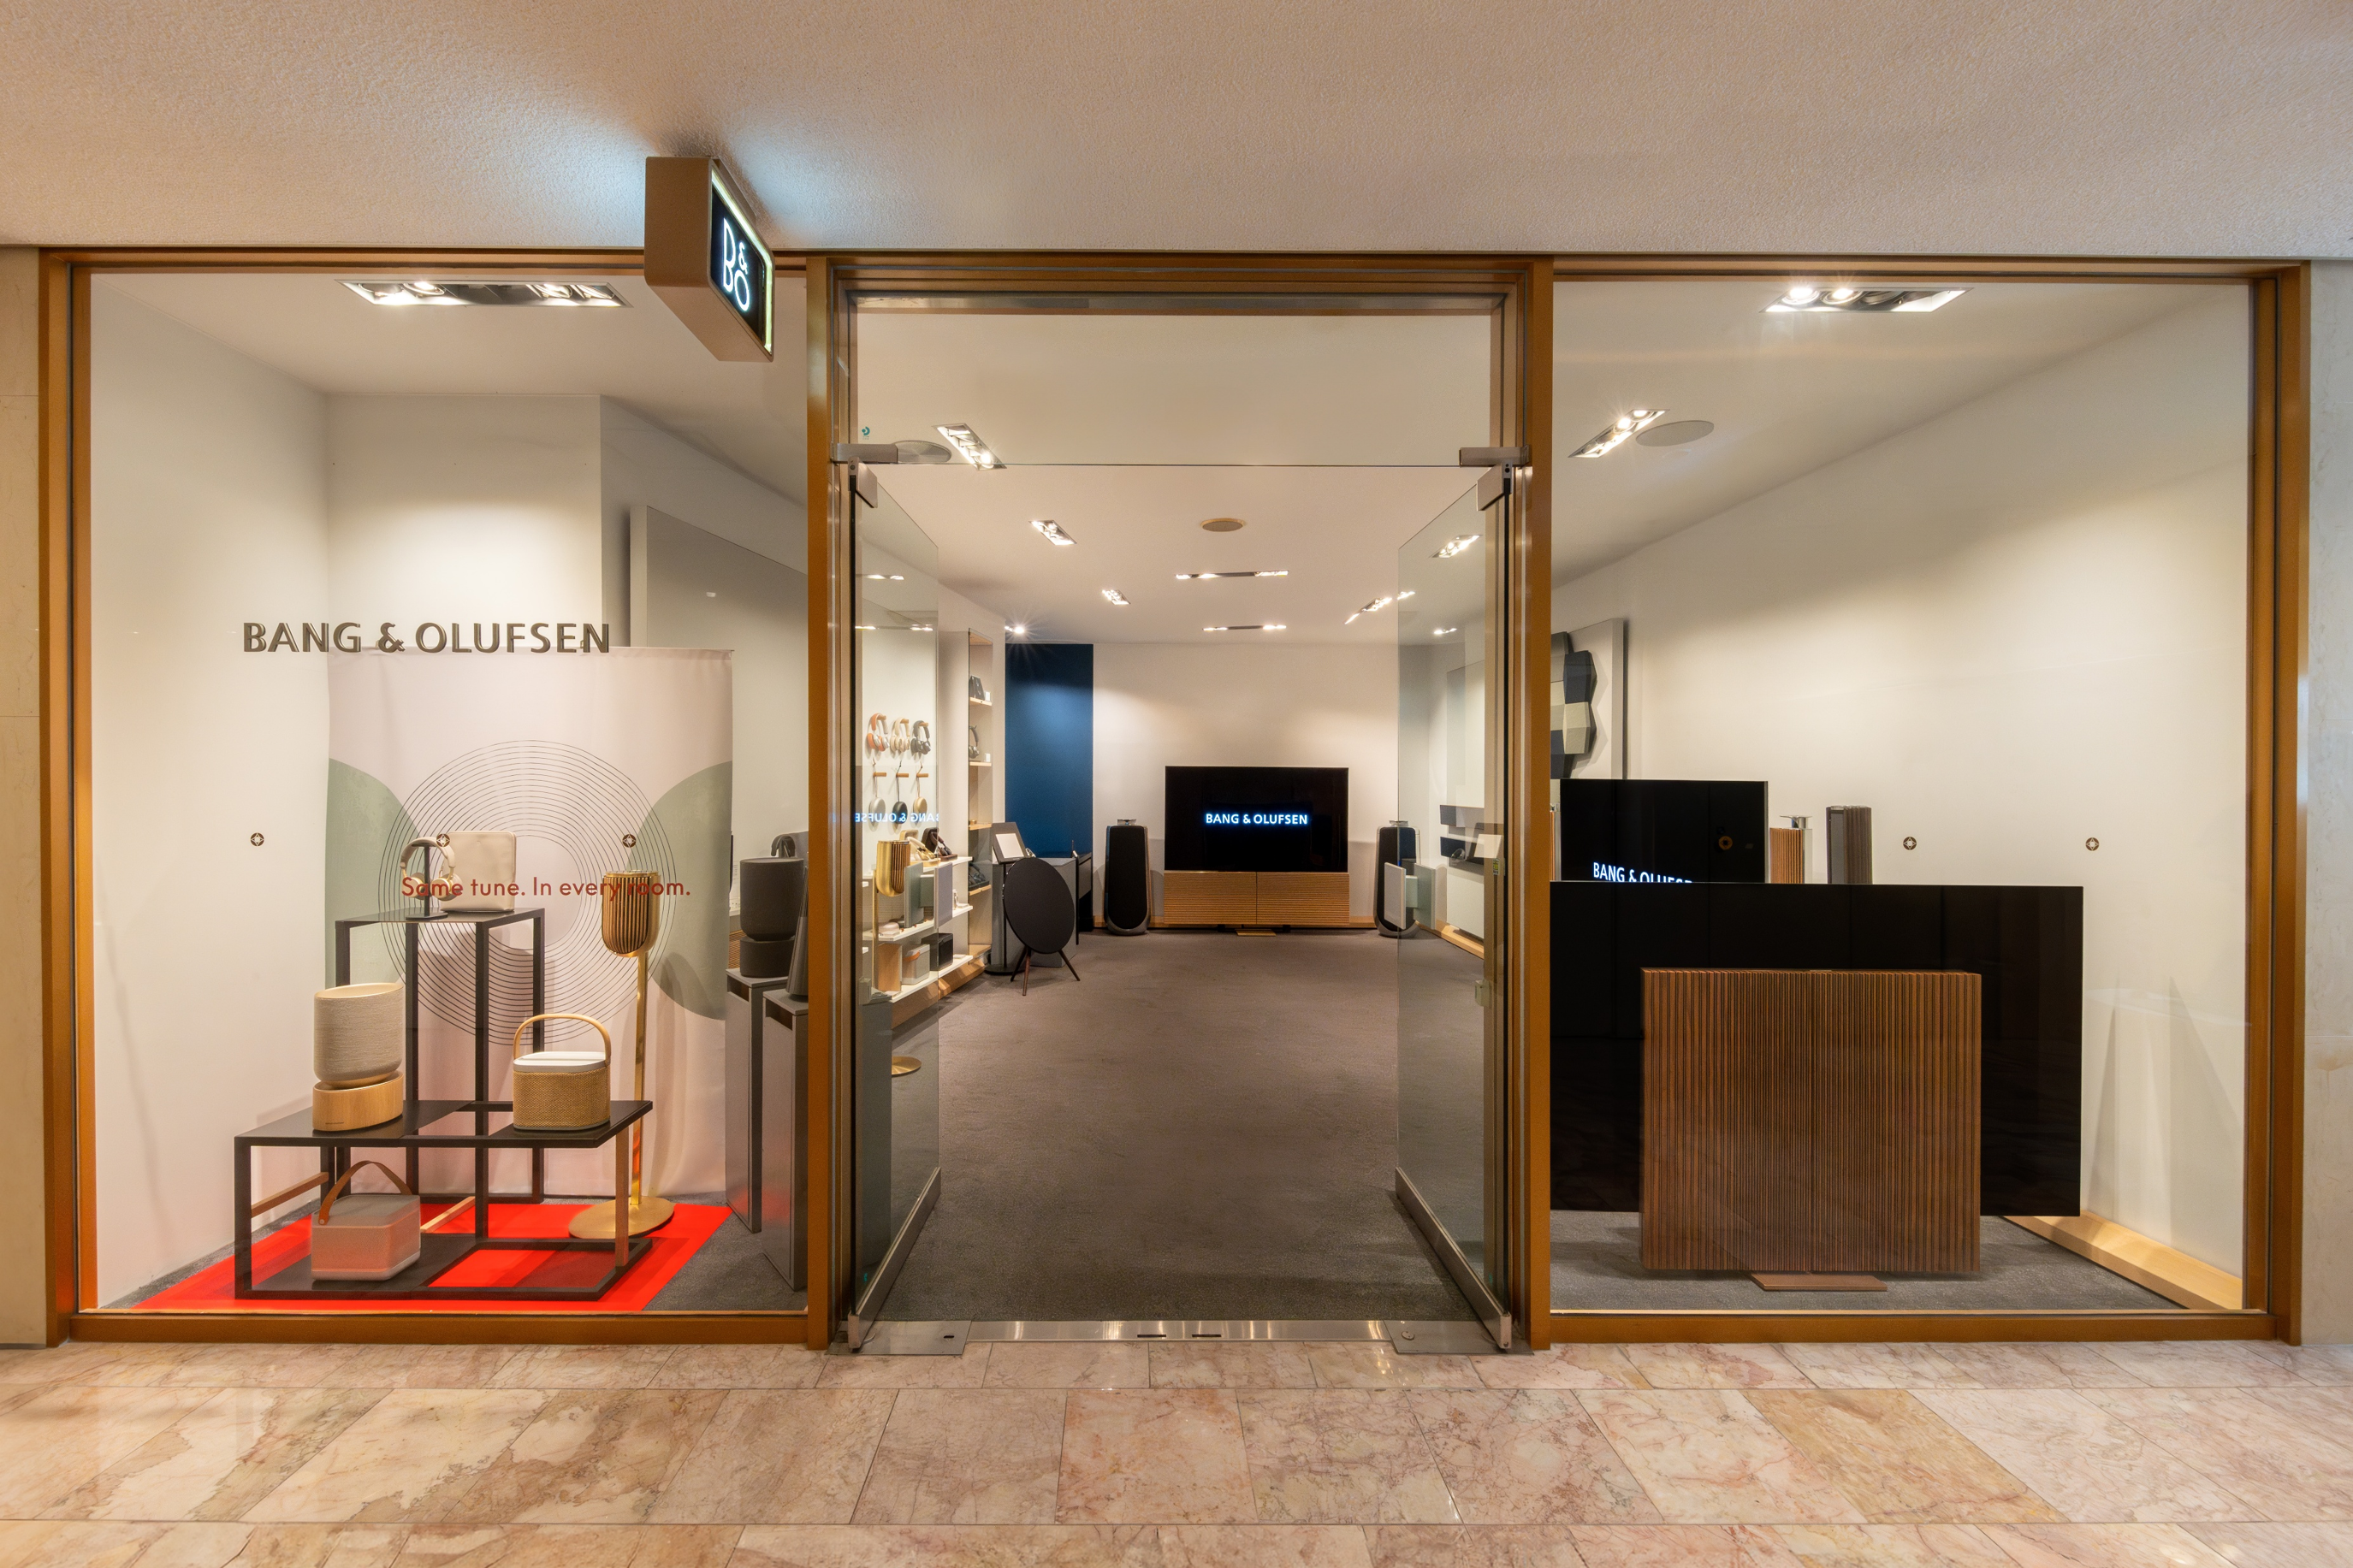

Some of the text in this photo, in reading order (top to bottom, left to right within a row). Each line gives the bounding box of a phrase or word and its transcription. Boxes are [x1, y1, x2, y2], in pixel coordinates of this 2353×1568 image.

[243, 622, 609, 654] BANG & OLUFSEN
[1206, 814, 1307, 825] BANG & OLUFSEN
[1593, 861, 1625, 882] BANG
[401, 877, 690, 902] Same tune. In every room.
